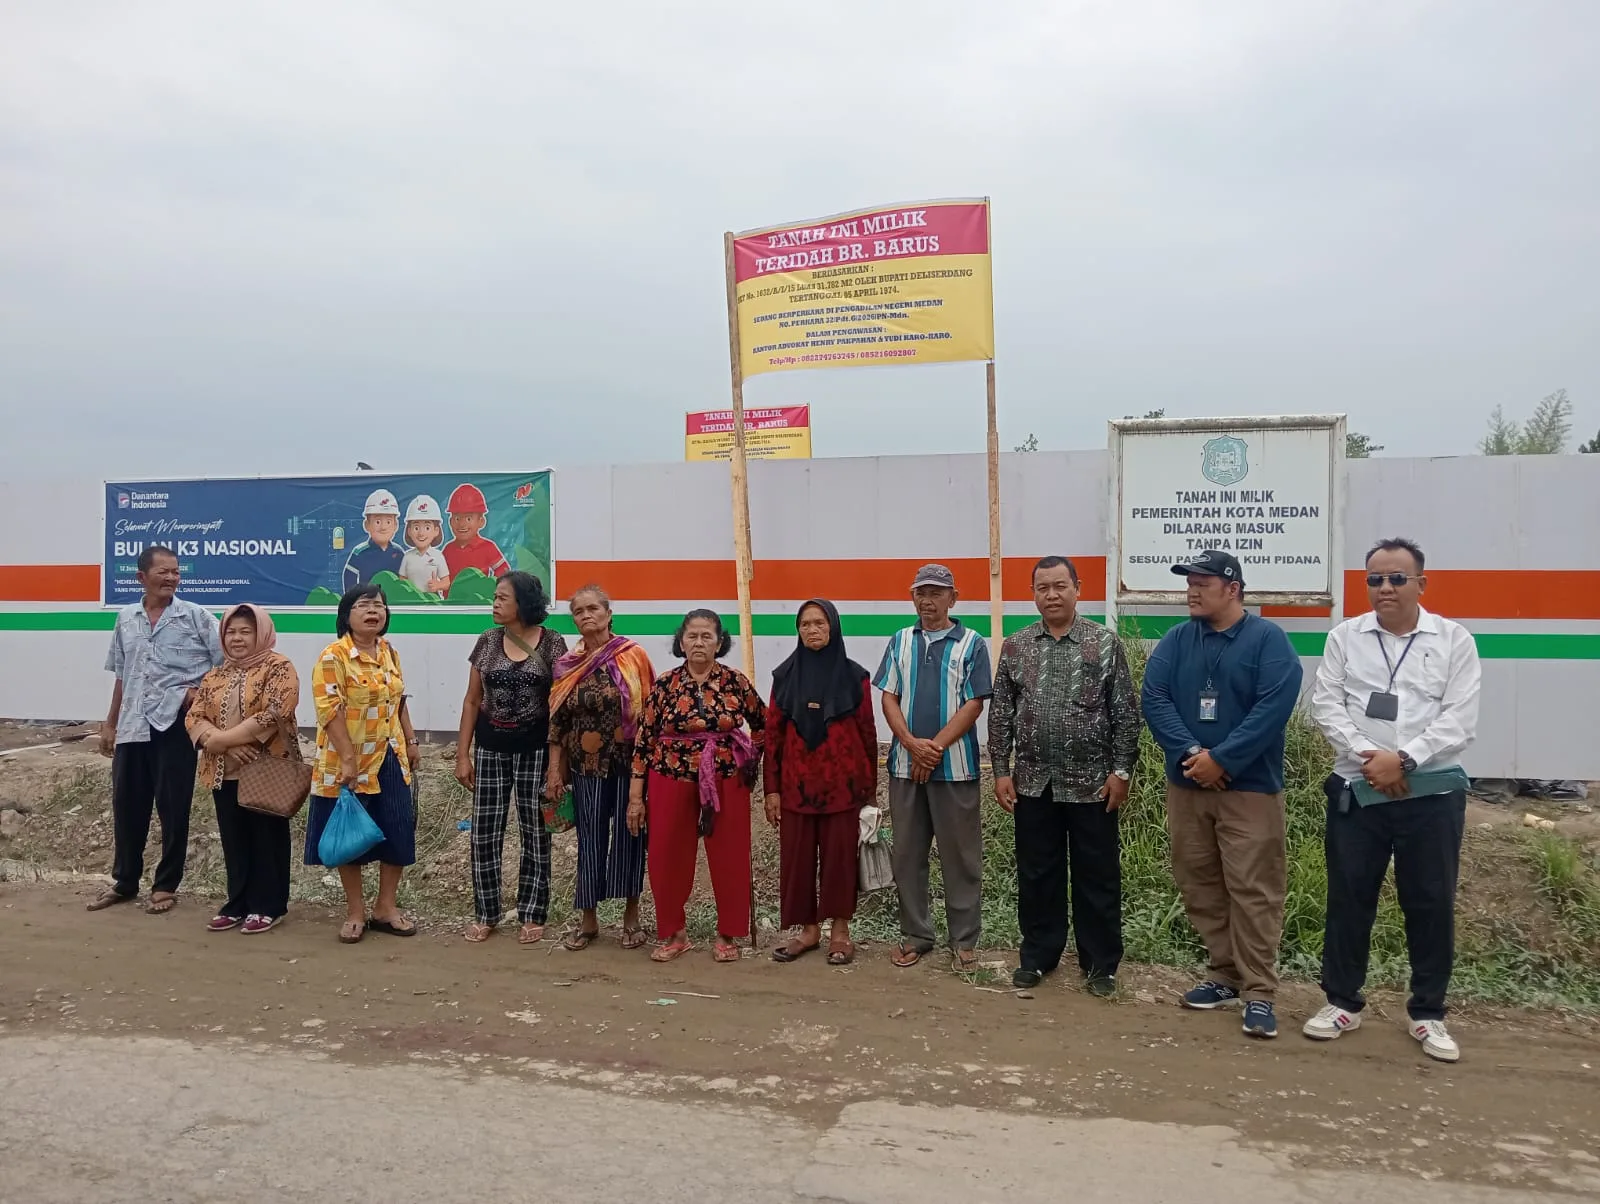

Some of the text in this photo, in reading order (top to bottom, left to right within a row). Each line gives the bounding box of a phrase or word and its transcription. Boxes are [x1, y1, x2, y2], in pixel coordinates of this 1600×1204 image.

[768, 210, 927, 248] TANAH INI MILIK
[756, 236, 940, 274] TERIDAH BR. BARUS
[812, 265, 870, 279] BERDASARKAN
[854, 276, 877, 286] OLEH
[878, 273, 910, 283] BUPATI
[910, 269, 973, 280] DELISERDANG
[789, 292, 842, 304] TERTANGGAL
[853, 288, 878, 298] APRIL
[778, 308, 824, 319] BERPERKARA
[835, 304, 883, 313] PENGADILAN
[884, 301, 913, 310] NEGERI
[914, 299, 943, 307] MEDAN
[806, 330, 831, 338] DALAM
[832, 327, 883, 336] PENGAWASAN
[752, 344, 777, 354] KANTOR
[778, 341, 810, 350] ADVOKAT
[704, 411, 733, 420] TANAH
[752, 410, 782, 418] MILIK
[758, 420, 788, 428] BARUS
[131, 492, 168, 500] Danantara
[1176, 490, 1274, 503] TANAH INI MILIK
[131, 500, 167, 509] Indonesia
[1132, 506, 1319, 518] PEMERINTAH KOTA MEDAN
[115, 518, 224, 536] Selamat Memperingati
[1163, 522, 1285, 534] DILARANG MASUK
[178, 541, 199, 556] K3
[204, 540, 297, 556] NASIONAL
[1186, 538, 1263, 550] TANPA IZIN
[1129, 556, 1172, 564] SESUAI
[1244, 556, 1270, 564] KUH
[1274, 556, 1321, 564] PIDANA
